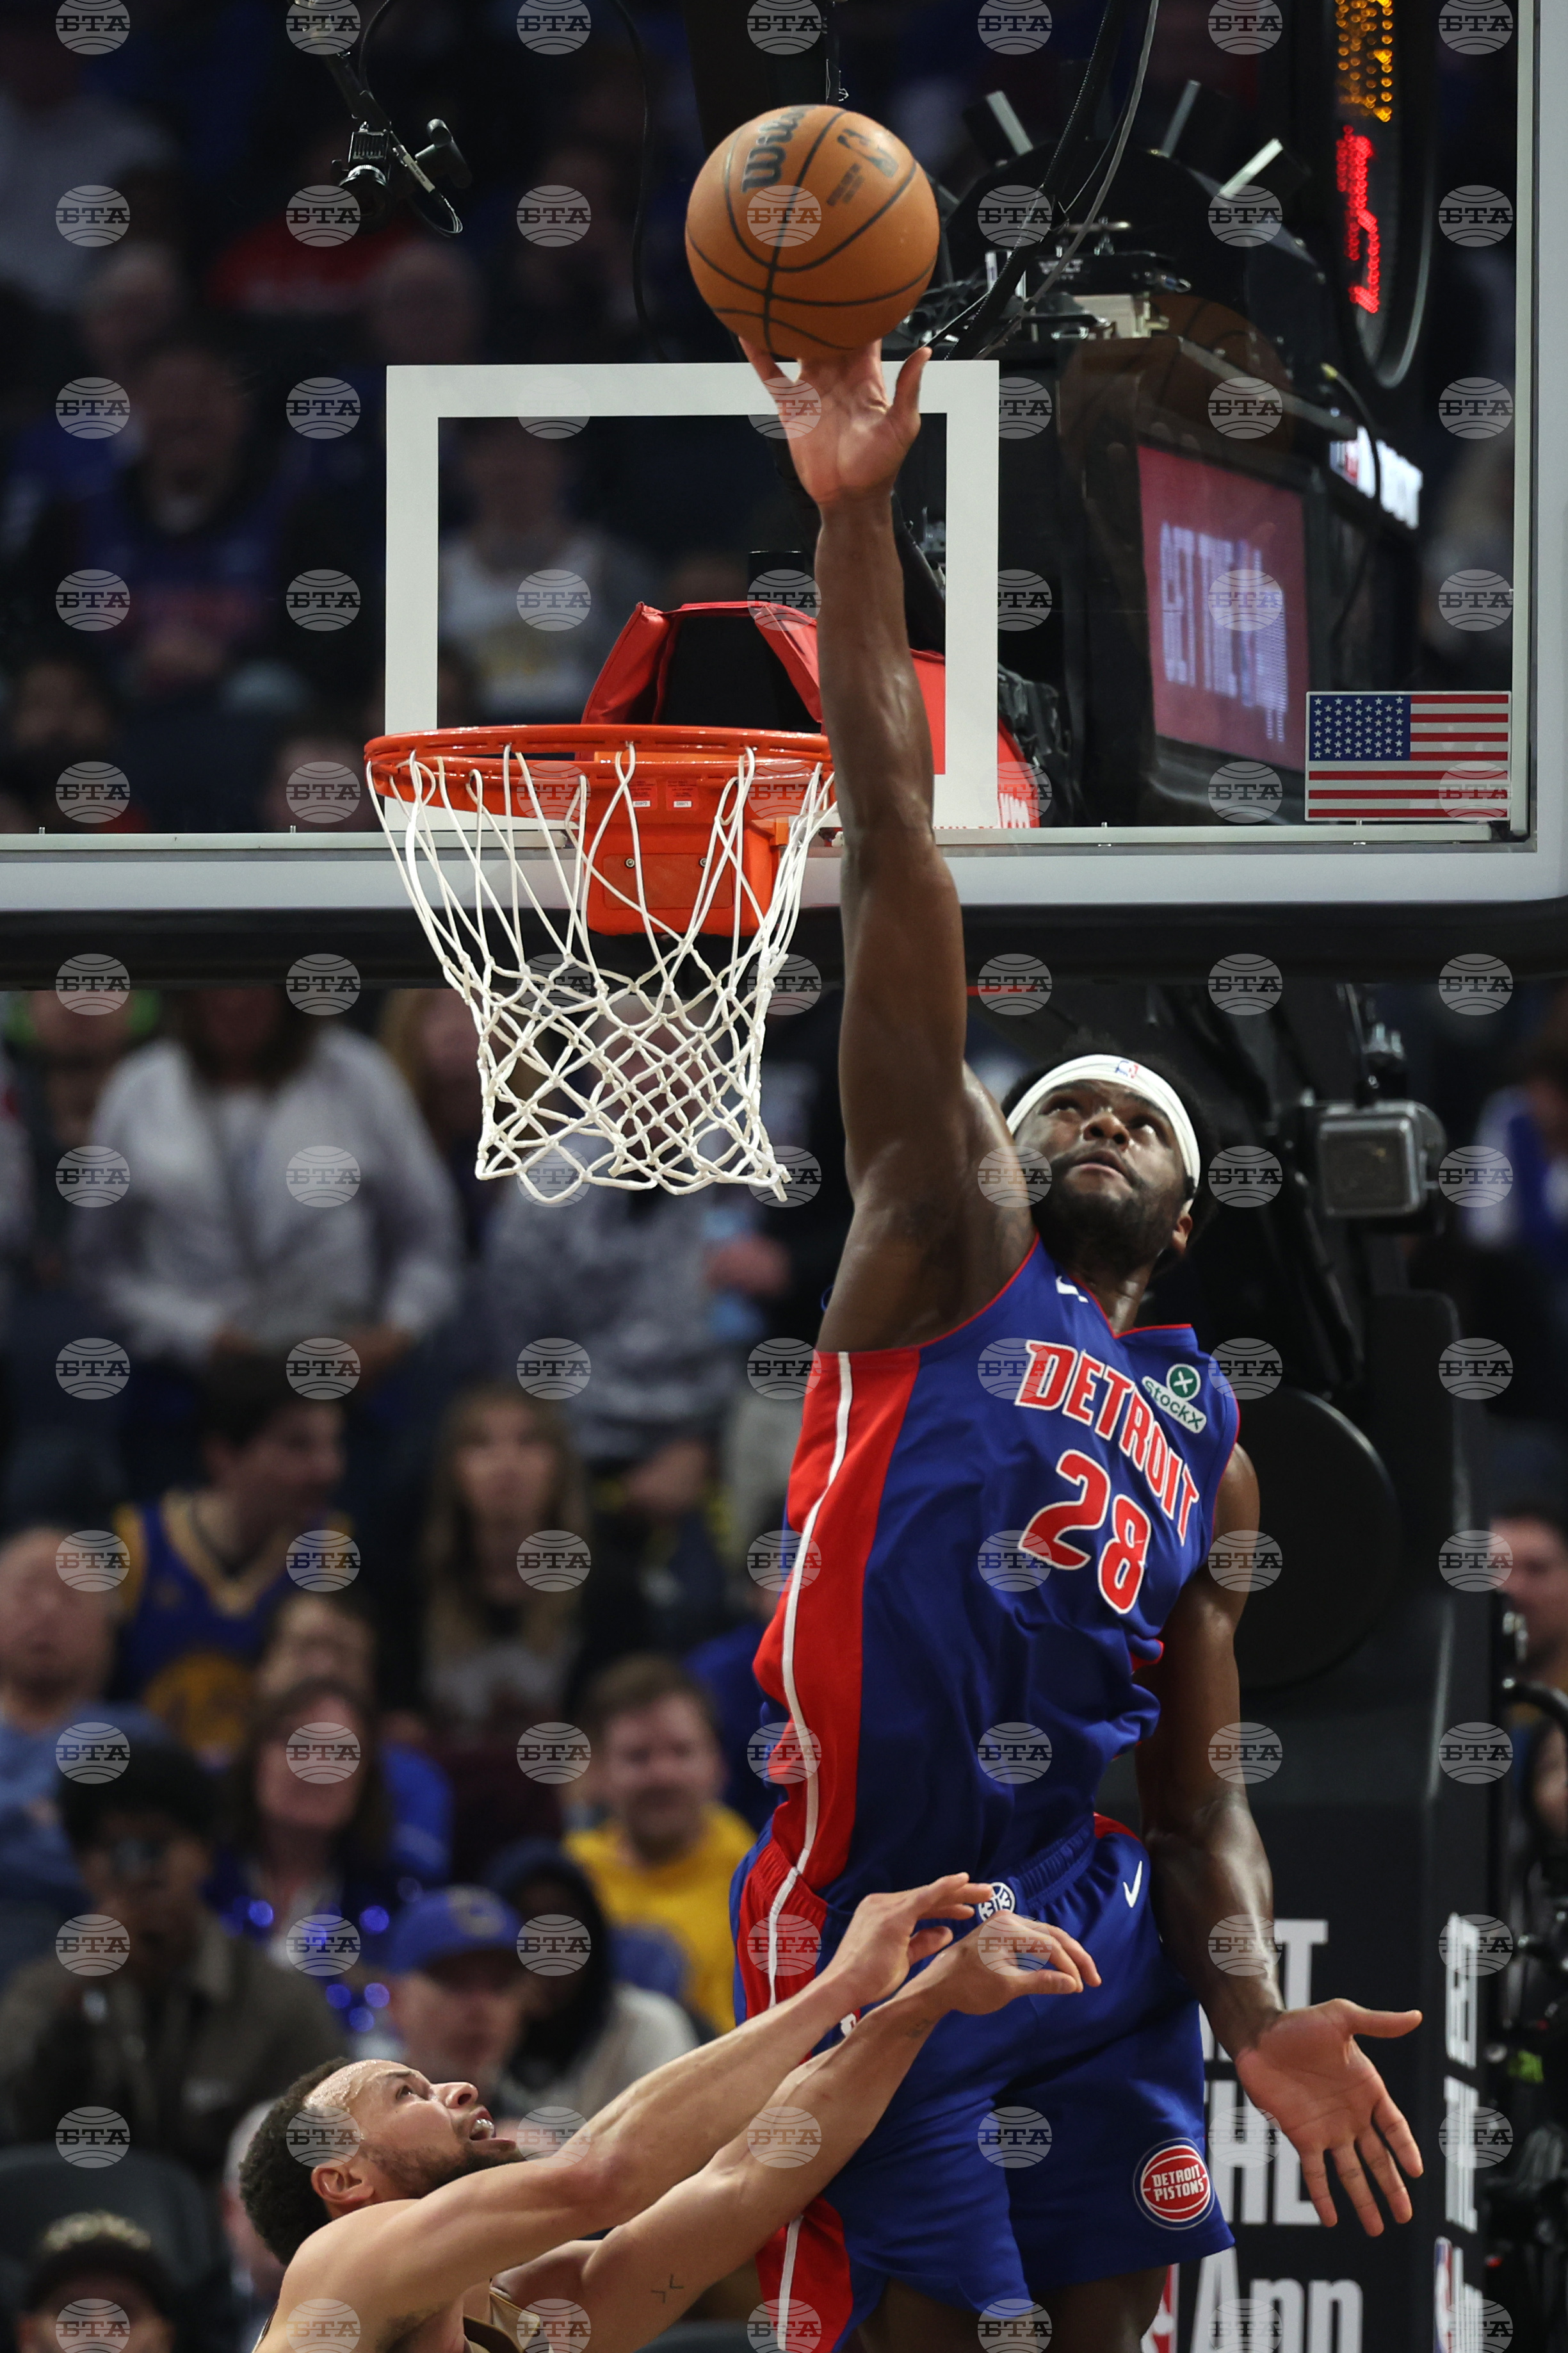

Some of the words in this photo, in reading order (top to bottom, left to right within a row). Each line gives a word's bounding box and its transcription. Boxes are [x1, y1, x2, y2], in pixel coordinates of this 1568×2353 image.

[1015, 1340, 1199, 1546] DETROIT
[1017, 1449, 1151, 1614] 28
[1152, 2164, 1200, 2187] DETROIT
[1154, 2178, 1204, 2202] PISTONS
